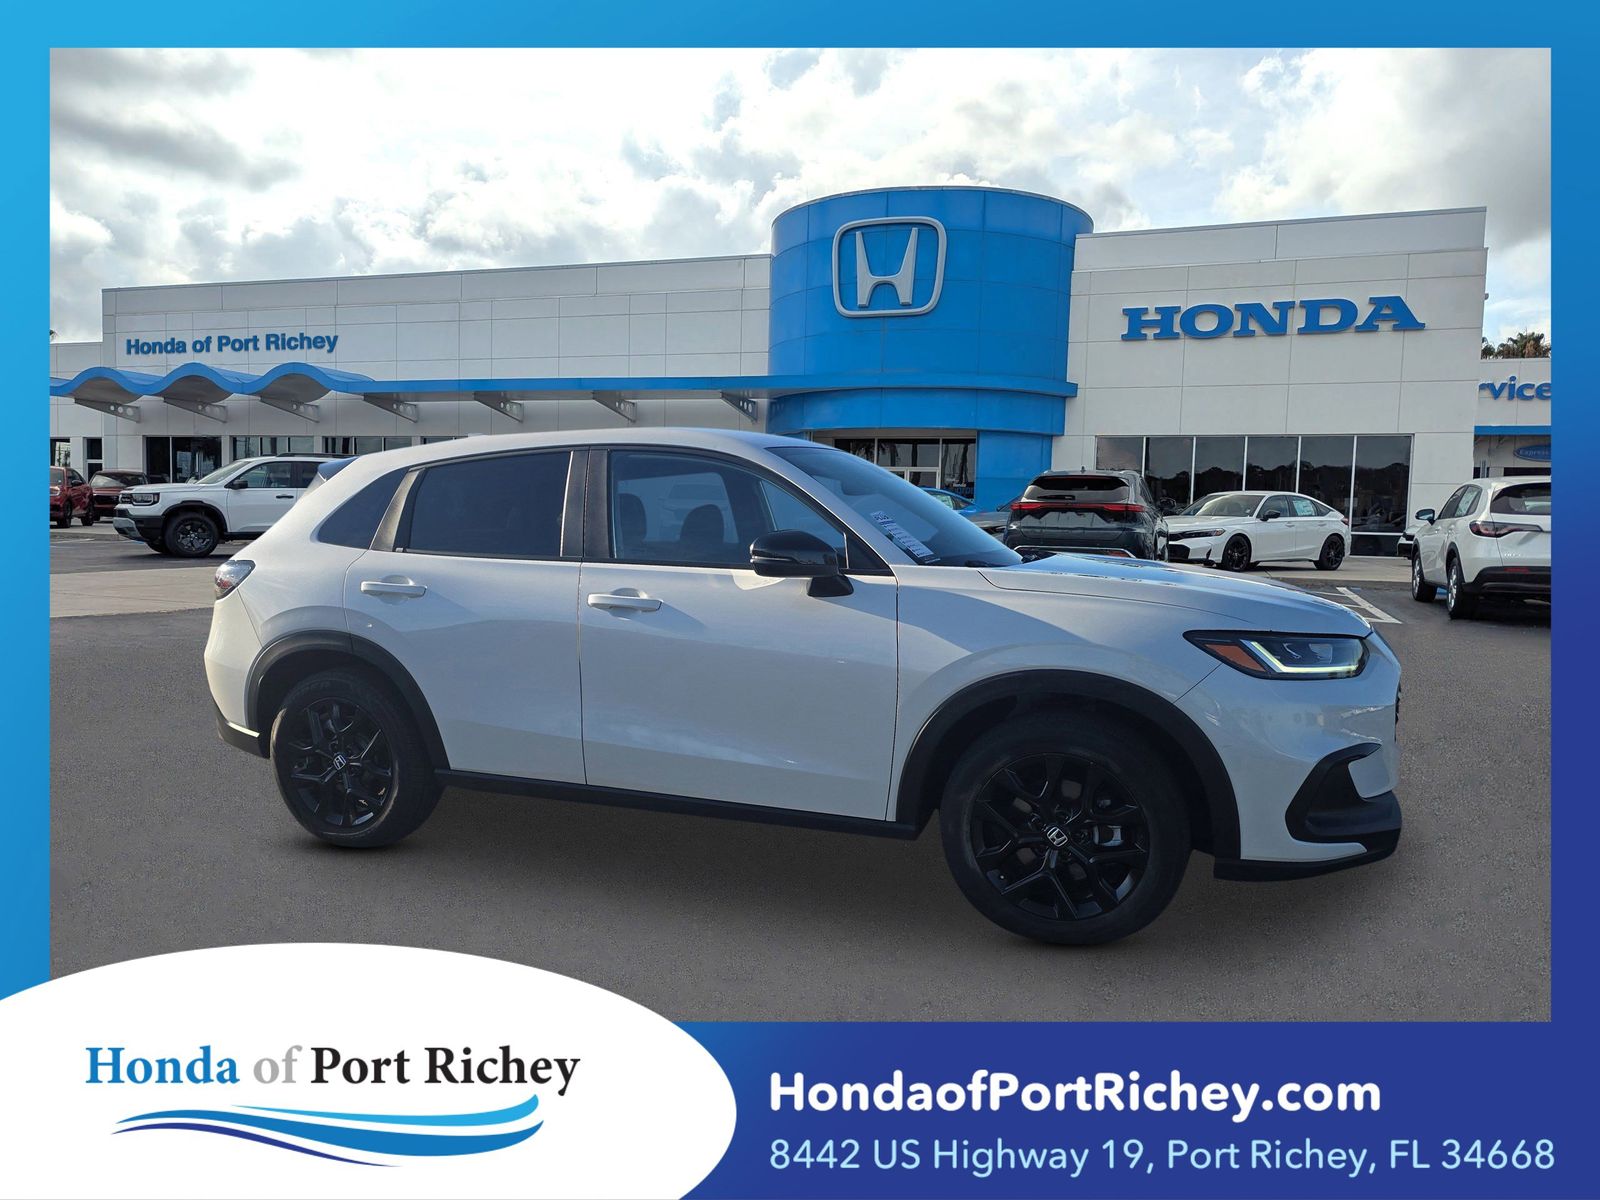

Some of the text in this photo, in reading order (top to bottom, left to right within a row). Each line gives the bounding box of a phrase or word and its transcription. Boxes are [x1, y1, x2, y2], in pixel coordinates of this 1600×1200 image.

[1120, 295, 1426, 341] HONDA
[126, 332, 338, 355] Honda of Port Richey
